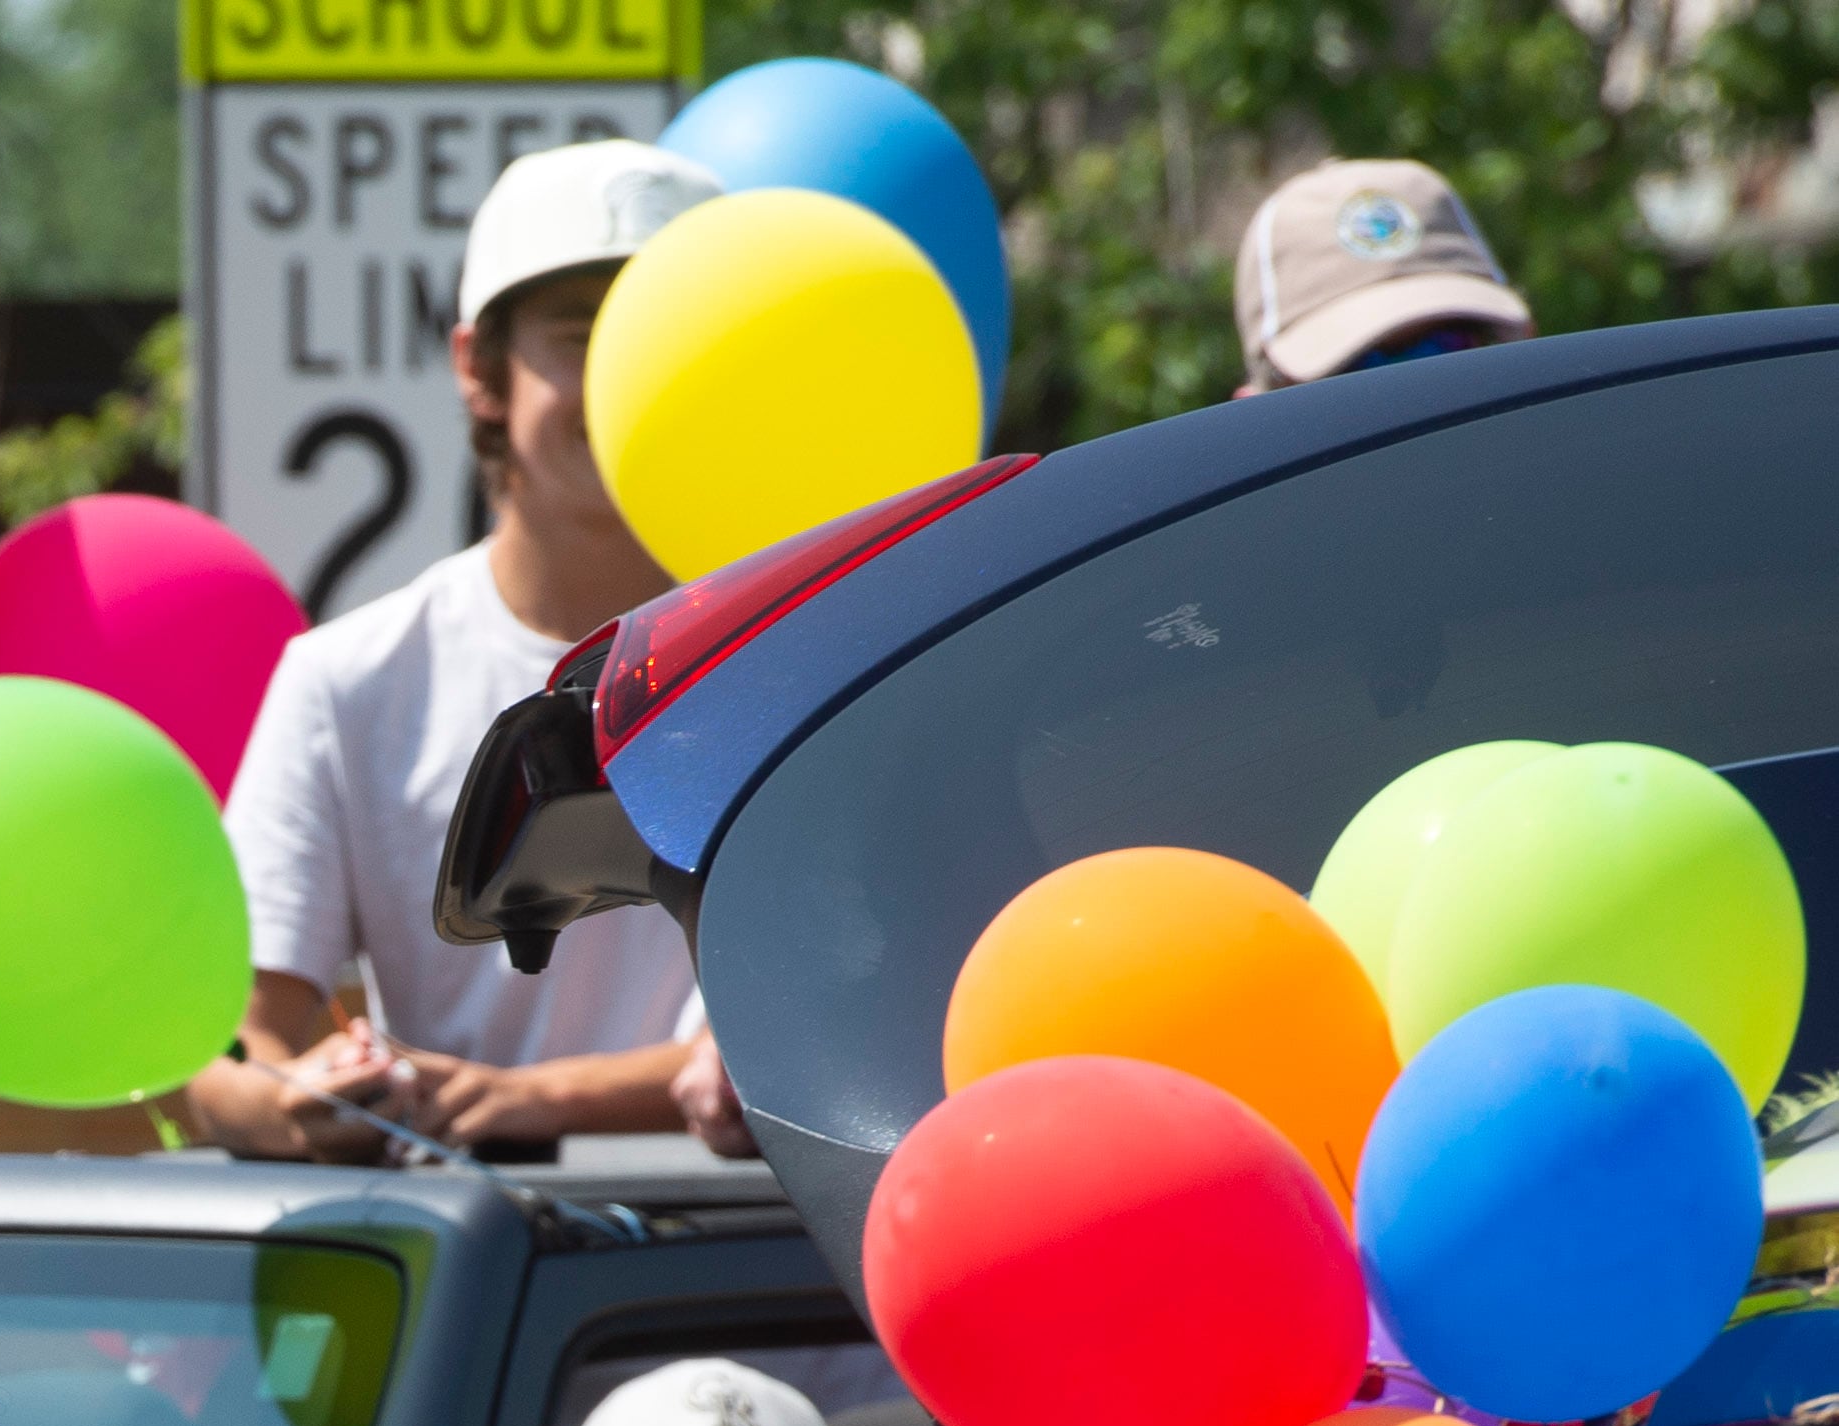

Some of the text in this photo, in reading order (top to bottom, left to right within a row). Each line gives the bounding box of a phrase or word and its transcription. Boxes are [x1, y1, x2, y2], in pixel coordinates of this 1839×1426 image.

[250, 110, 631, 233] SPEE
[287, 257, 461, 377] LIM
[280, 407, 489, 626] 2
